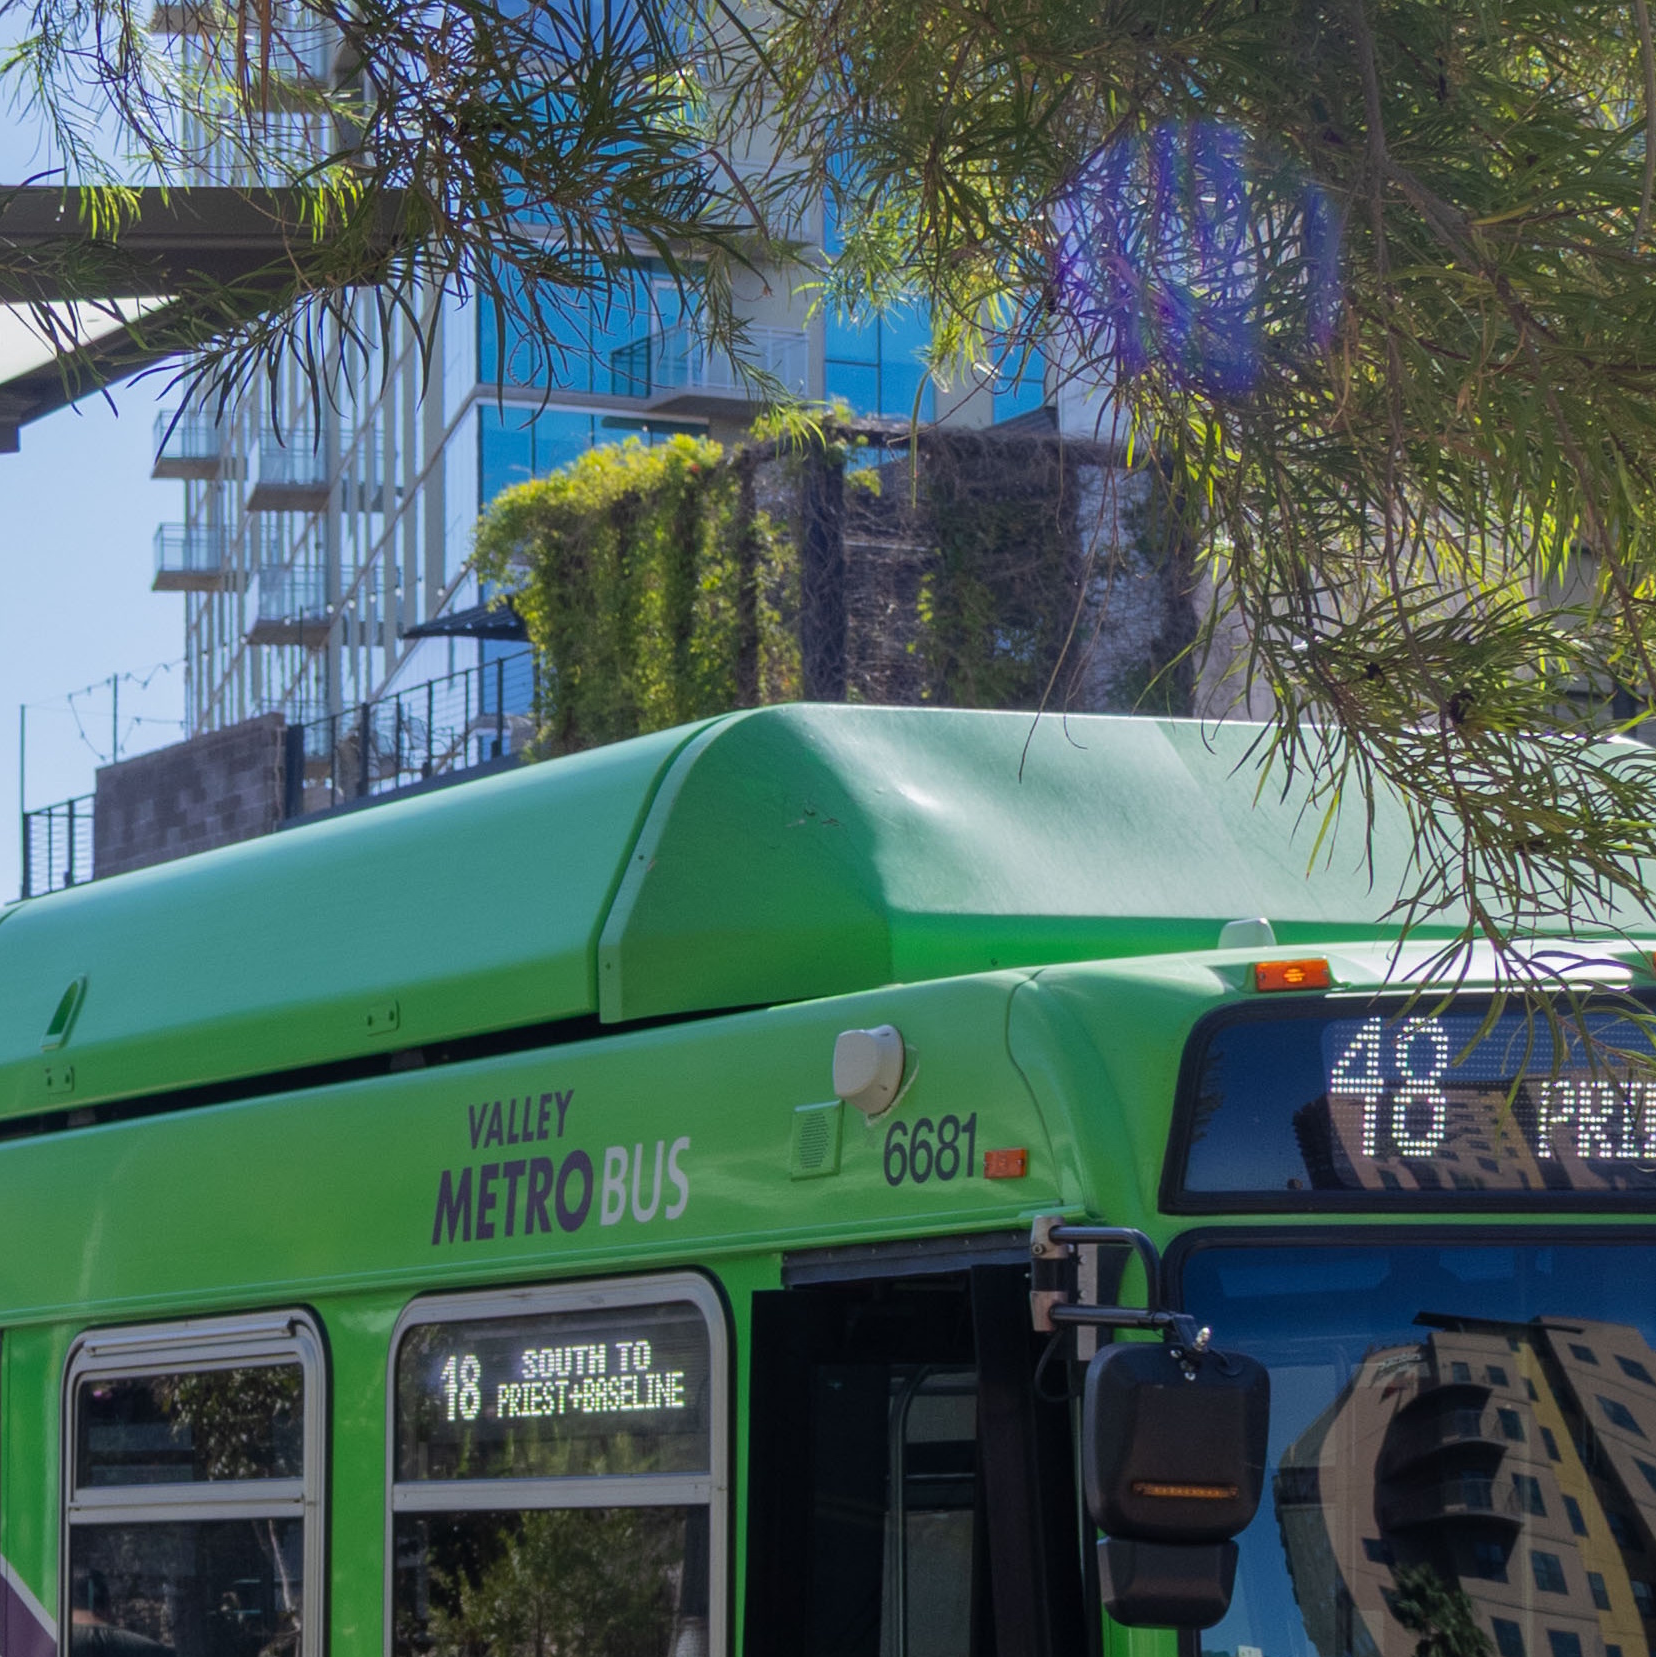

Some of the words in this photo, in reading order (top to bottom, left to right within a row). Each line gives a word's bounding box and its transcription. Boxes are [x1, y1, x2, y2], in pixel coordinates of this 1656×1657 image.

[468, 1089, 575, 1150] VALLEY
[1329, 1016, 1449, 1157] 48
[883, 1112, 977, 1187] 6681
[521, 1343, 608, 1381] SOUTH
[615, 1339, 652, 1372] TO
